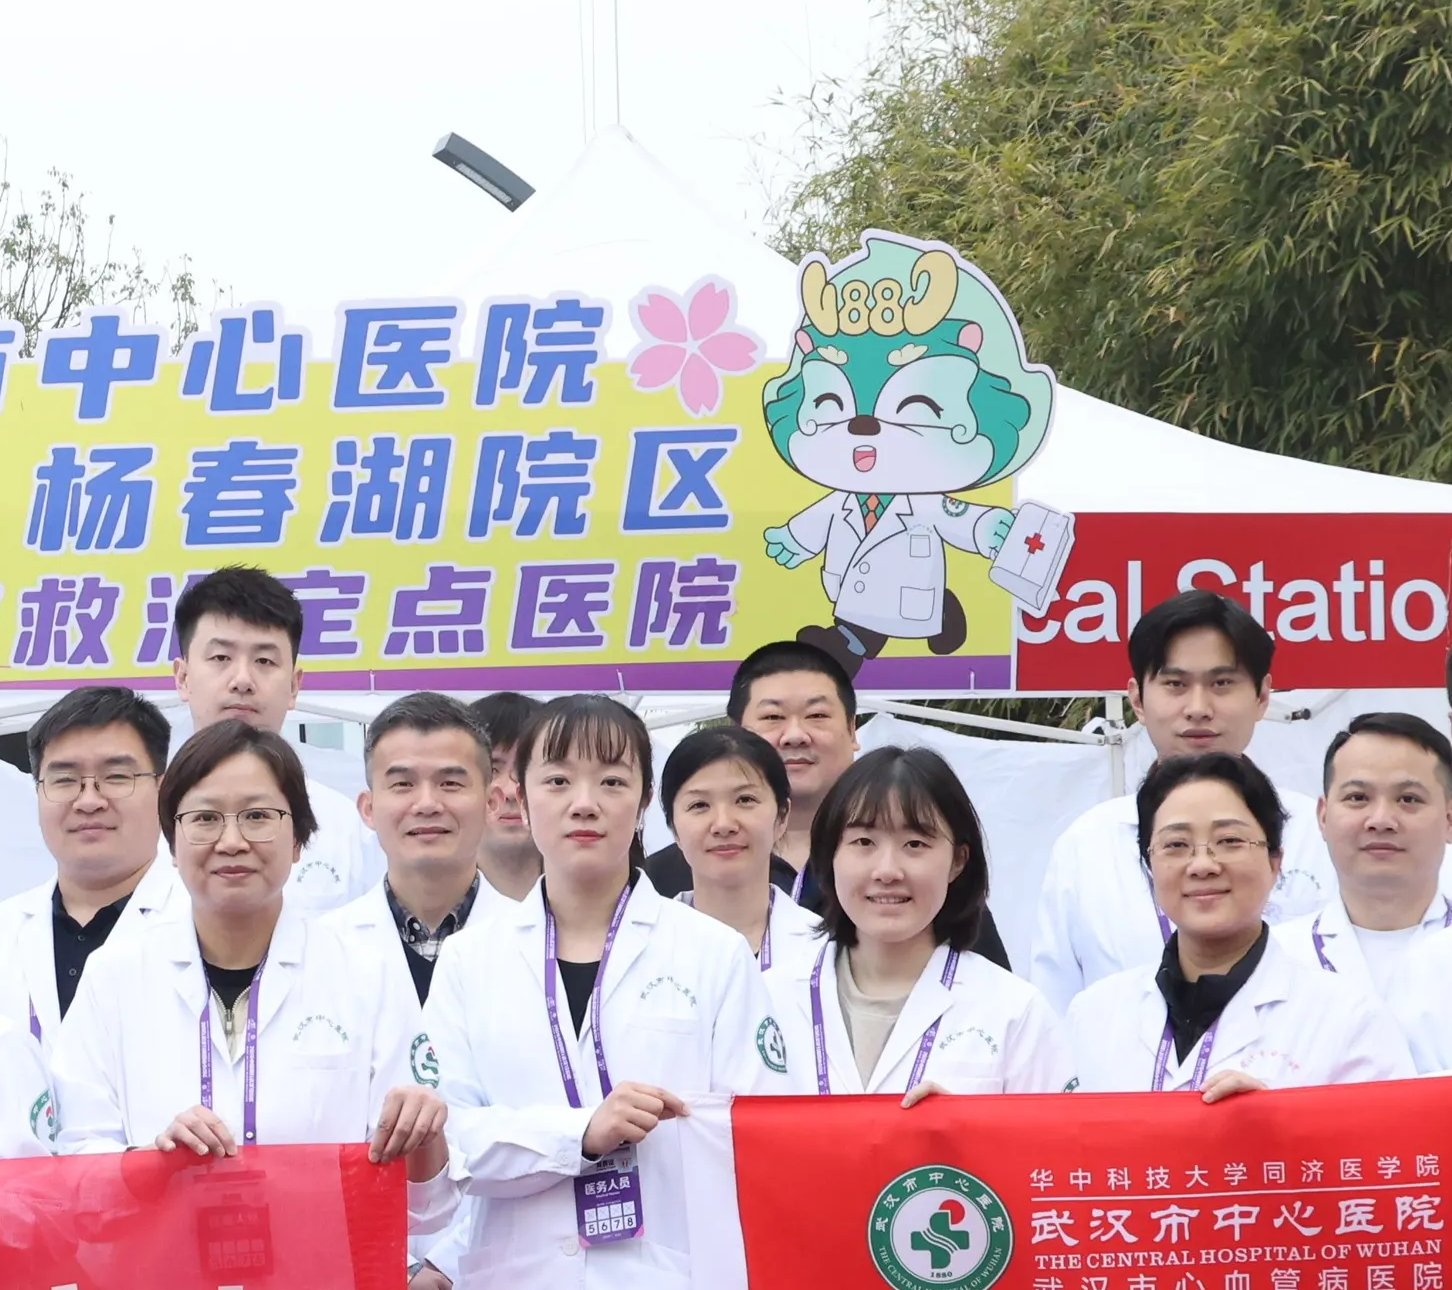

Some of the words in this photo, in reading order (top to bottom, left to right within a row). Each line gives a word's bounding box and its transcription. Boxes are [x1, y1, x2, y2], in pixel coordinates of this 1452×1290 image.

[26, 427, 737, 554] 杨春湖院区
[584, 1176, 632, 1196] 医务人员
[1029, 1153, 1441, 1192] 华中科技大学同济医学院
[875, 1171, 1005, 1233] 武汉市中心医院
[1031, 1194, 1445, 1247] 武汉市中心医院
[588, 1223, 596, 1235] 5
[601, 1221, 609, 1232] 6
[614, 1219, 622, 1230] 7
[626, 1216, 635, 1227] 8
[878, 1245, 891, 1265] THE
[970, 1276, 983, 1289] OF
[980, 1246, 1003, 1279] WUHAN
[1034, 1253, 1082, 1270] THE
[1086, 1250, 1196, 1269] CENTRAL
[1199, 1245, 1316, 1265] HOSPITAL
[1320, 1244, 1352, 1260] OF
[1356, 1239, 1442, 1258] WUHAN
[930, 1270, 954, 1279] 1880
